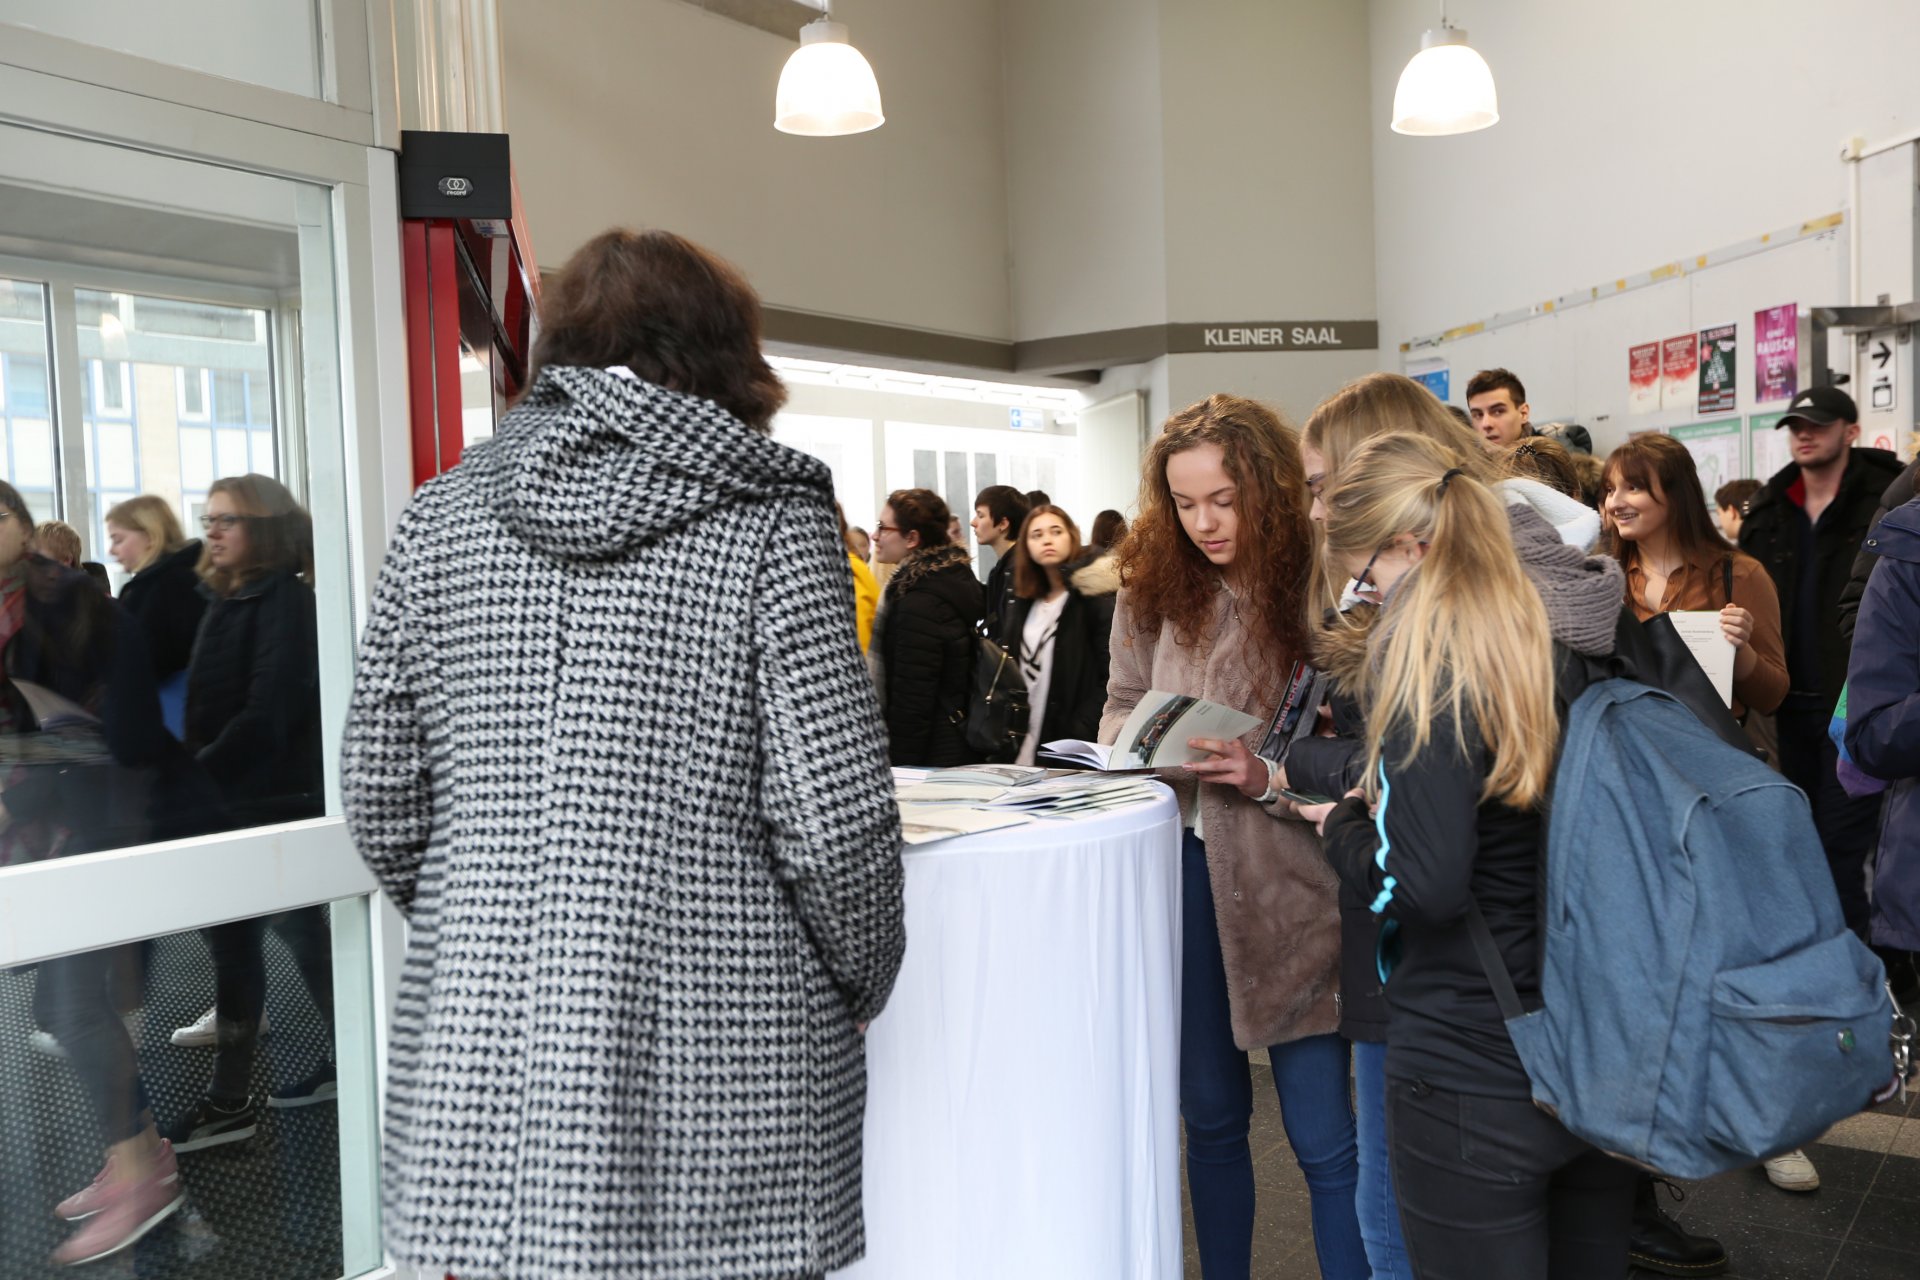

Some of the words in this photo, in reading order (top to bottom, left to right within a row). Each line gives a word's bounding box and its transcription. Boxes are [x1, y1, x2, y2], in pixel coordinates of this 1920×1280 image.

[1204, 328, 1283, 345] KLEINER
[1291, 327, 1342, 345] SAAL
[1757, 336, 1796, 354] RAUSCH
